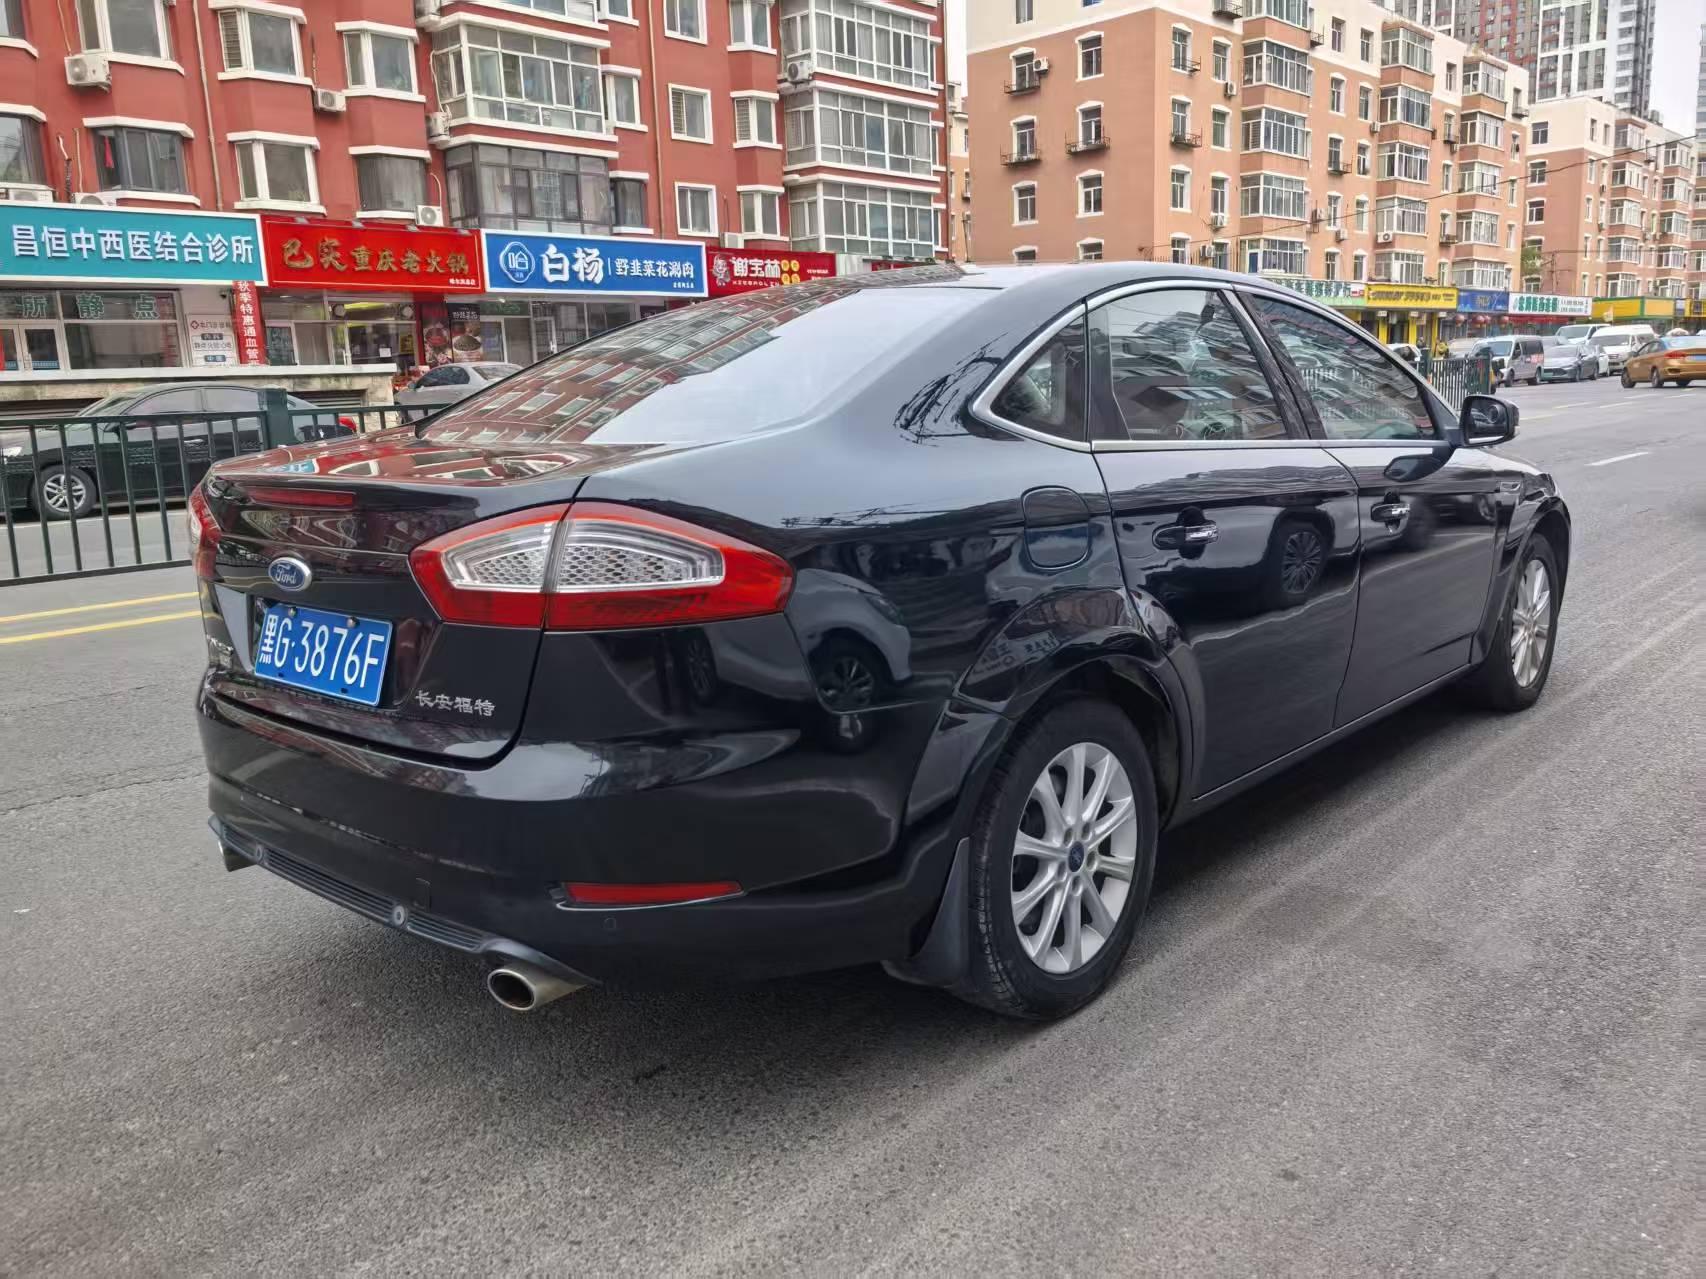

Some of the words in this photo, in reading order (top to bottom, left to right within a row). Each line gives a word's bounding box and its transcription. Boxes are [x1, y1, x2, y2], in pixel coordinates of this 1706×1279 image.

[12, 224, 254, 264] 昌恒中西医结合诊所
[540, 243, 604, 284] 白杨
[615, 258, 694, 279] 野韭菜花涮肉
[729, 256, 780, 278] 谢宝林
[275, 564, 298, 585] Ford
[415, 690, 496, 717] 长安福特
